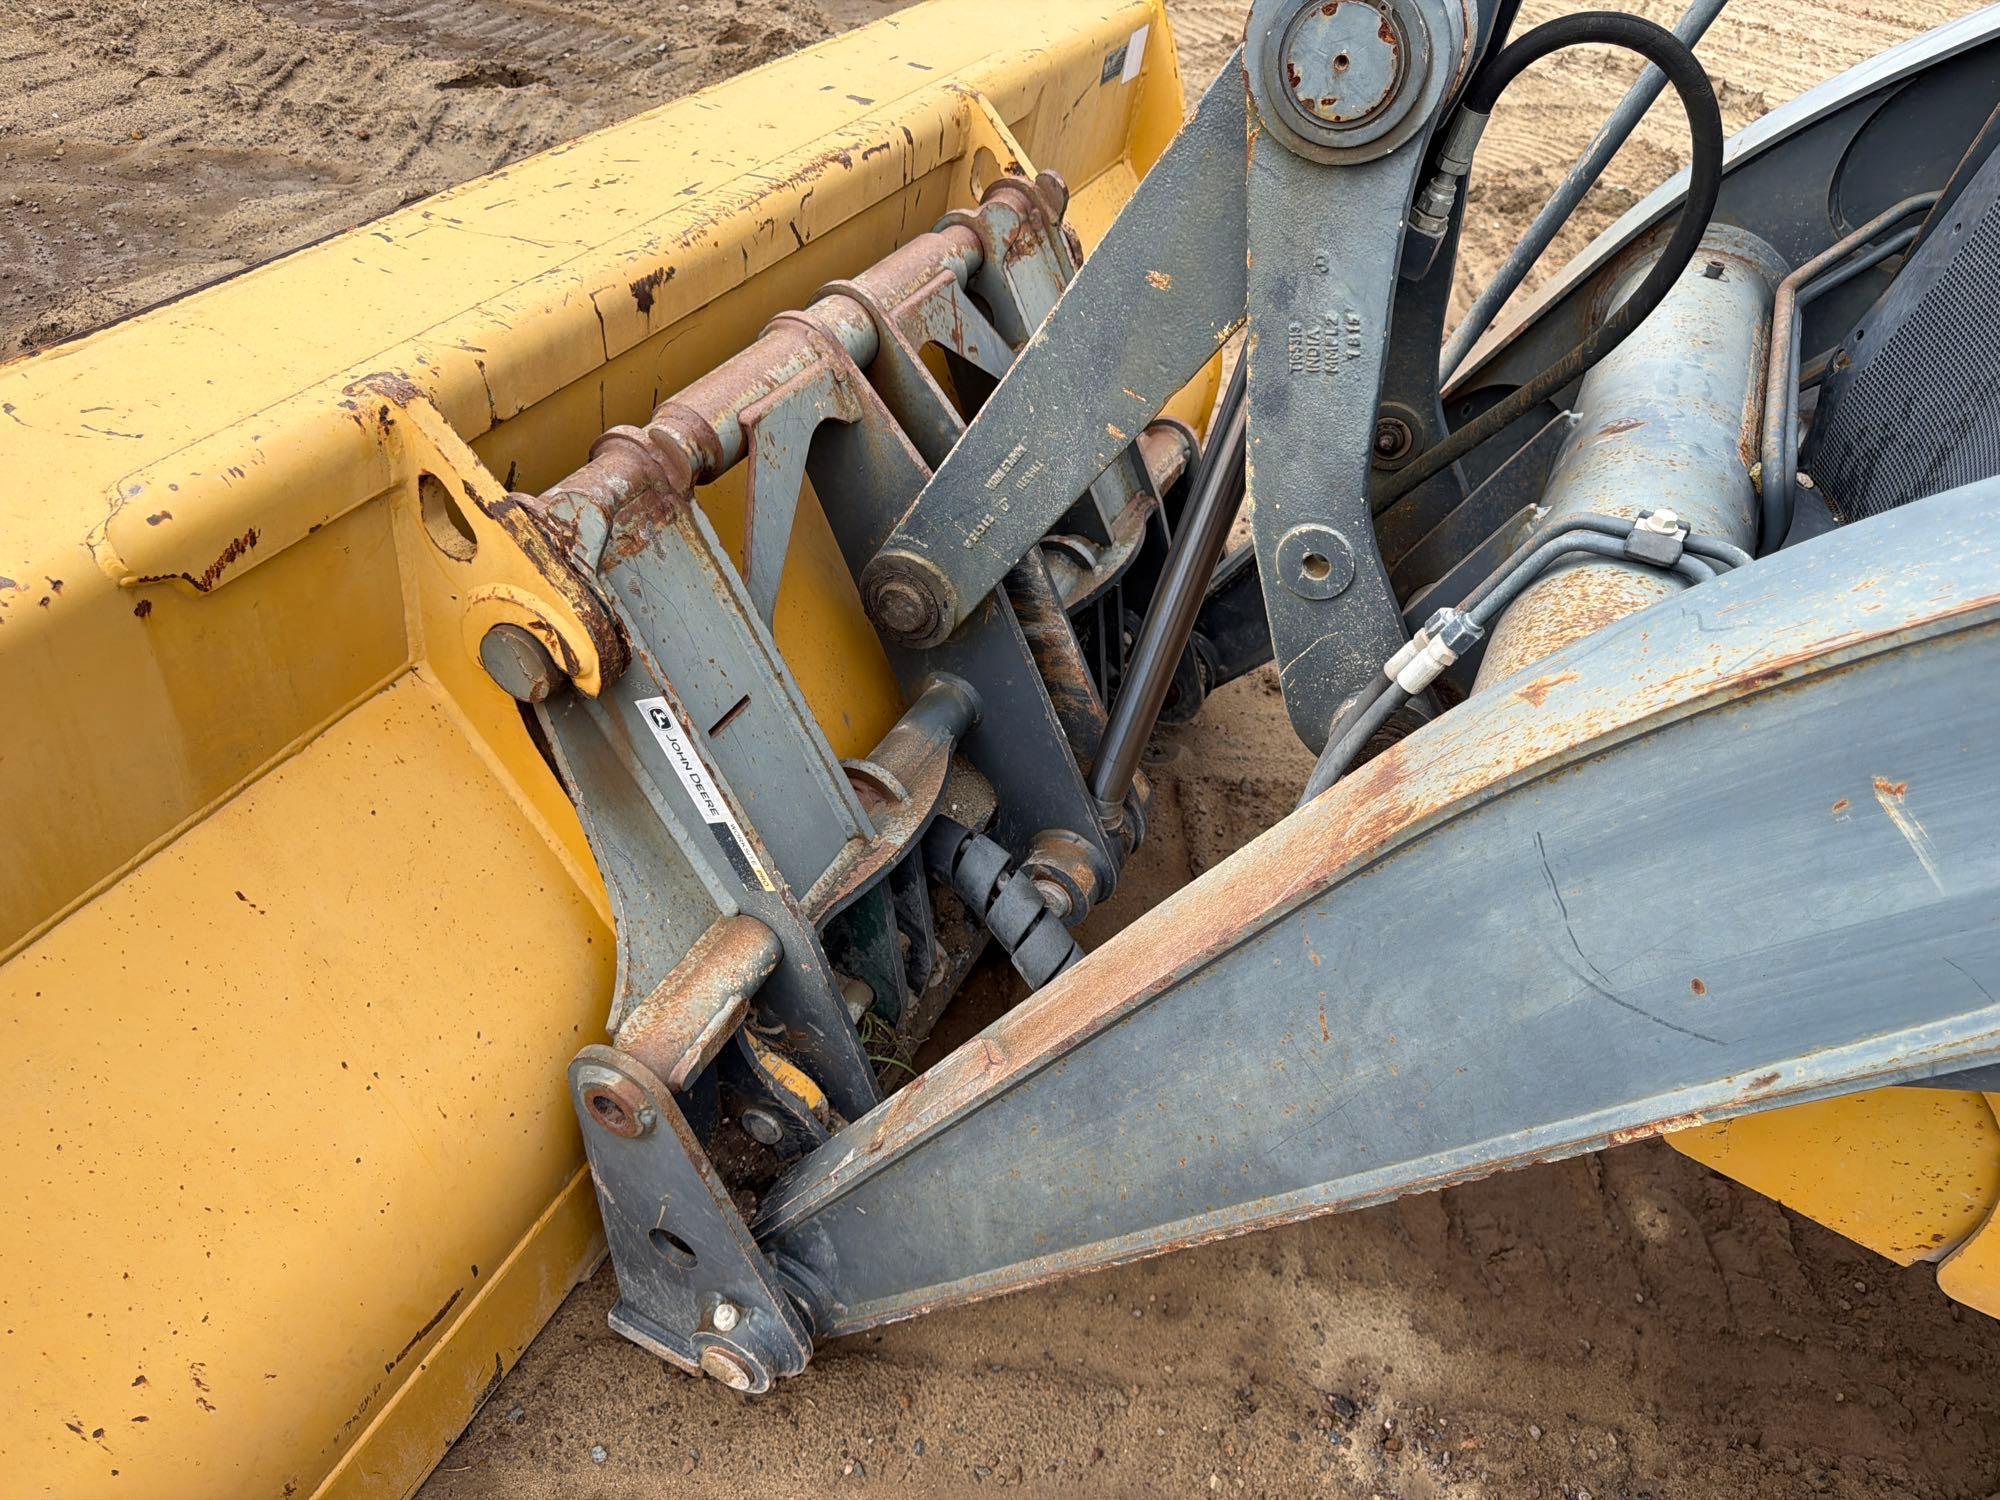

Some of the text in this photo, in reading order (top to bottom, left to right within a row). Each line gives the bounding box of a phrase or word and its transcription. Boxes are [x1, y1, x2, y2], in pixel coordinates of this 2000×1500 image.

[1305, 325, 1321, 373] INDIA
[666, 734, 720, 817] JOHN DEERE
[730, 823, 770, 888] WORKSITE PRO
